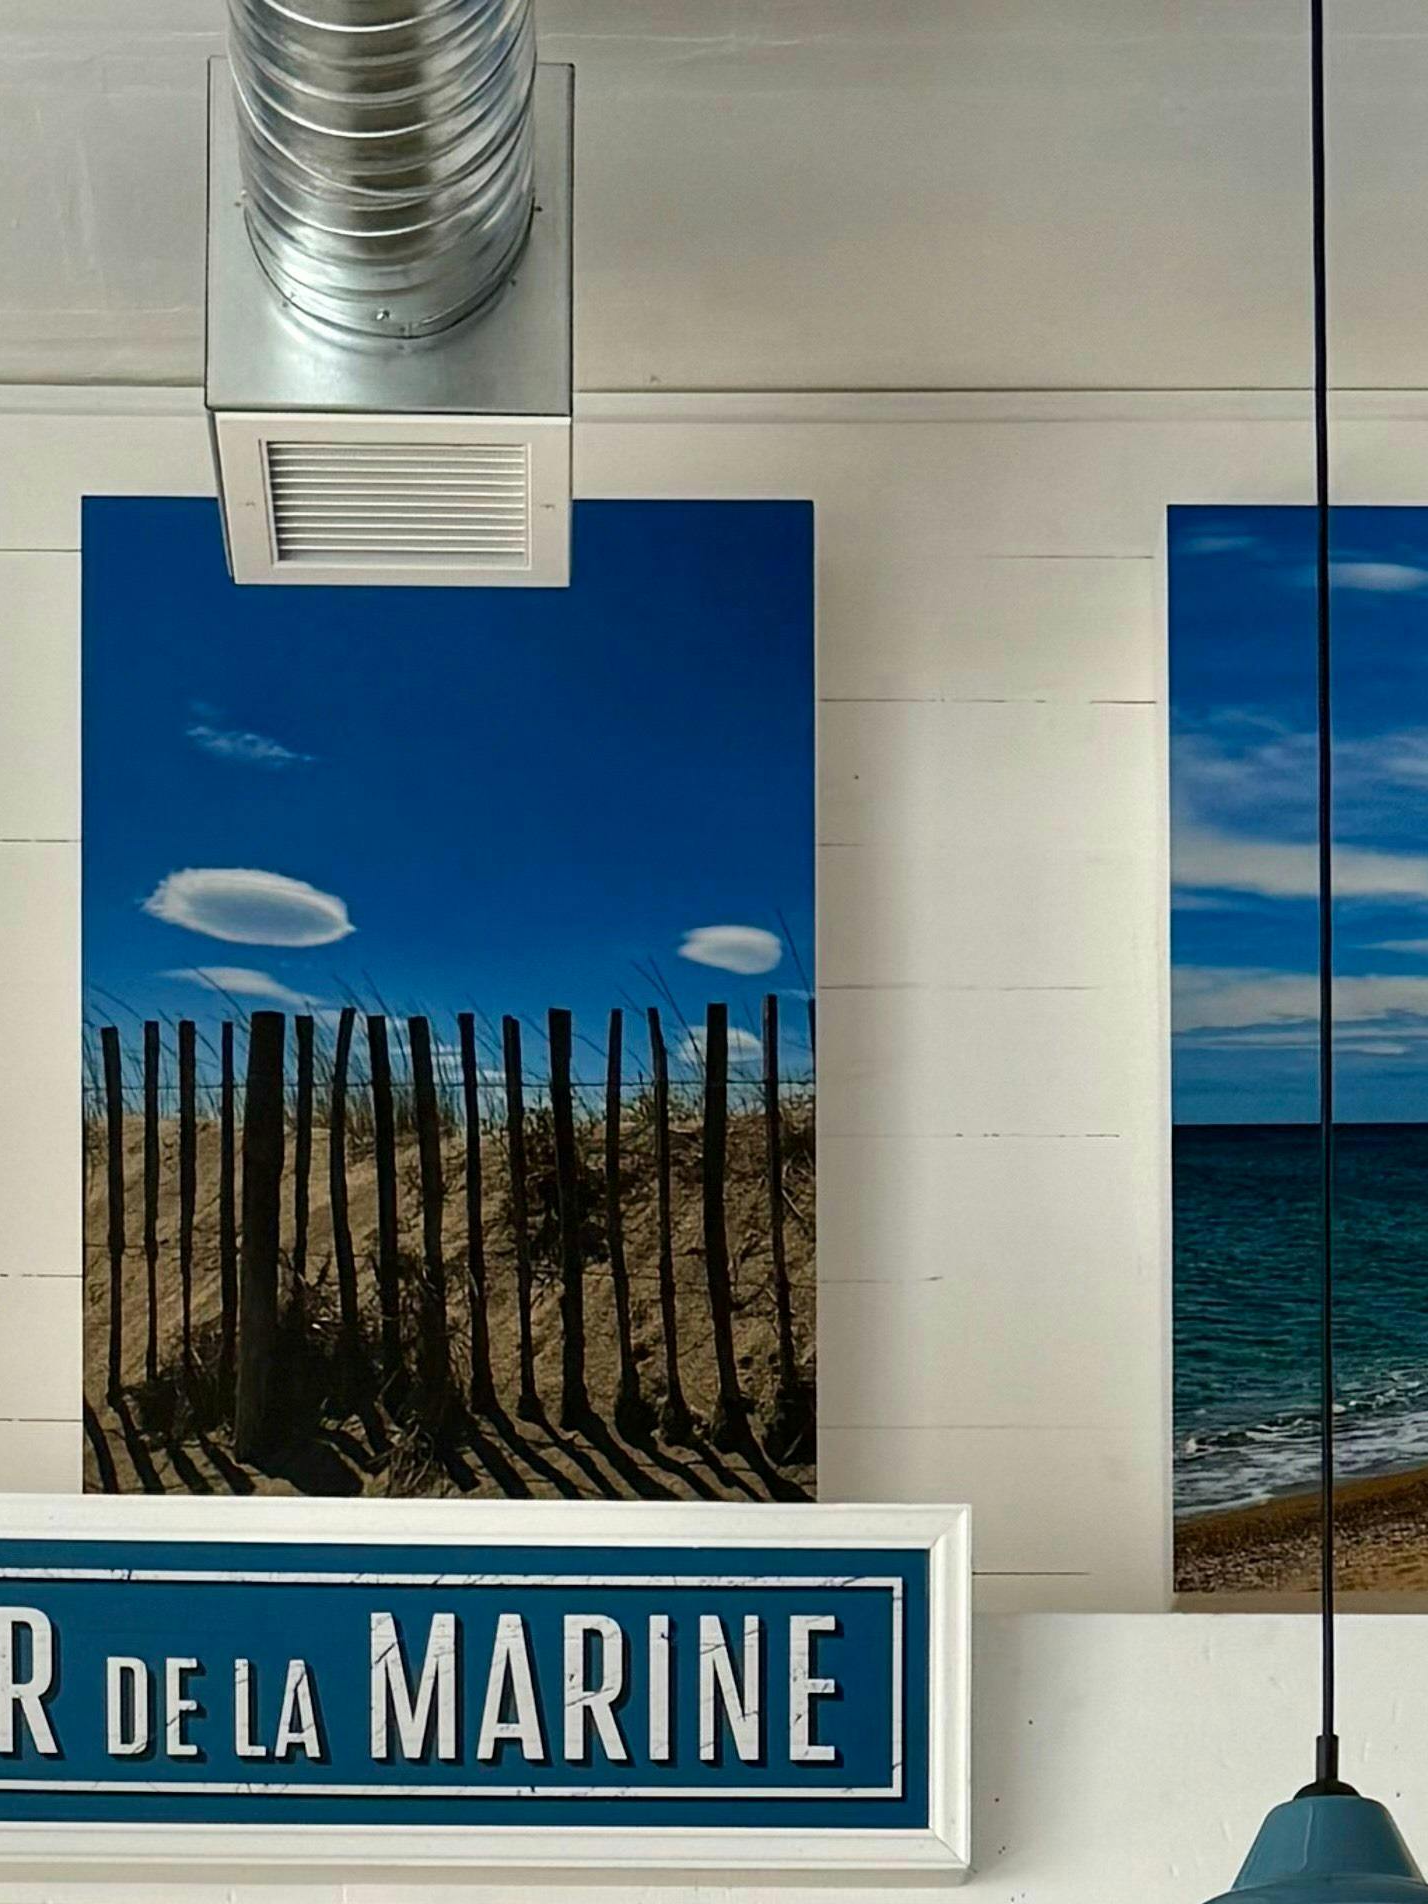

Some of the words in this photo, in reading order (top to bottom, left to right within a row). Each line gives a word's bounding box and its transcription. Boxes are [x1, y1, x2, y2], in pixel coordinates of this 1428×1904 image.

[106, 1655, 199, 1760] DE
[233, 1657, 322, 1762] LA
[371, 1611, 838, 1764] MARINE
